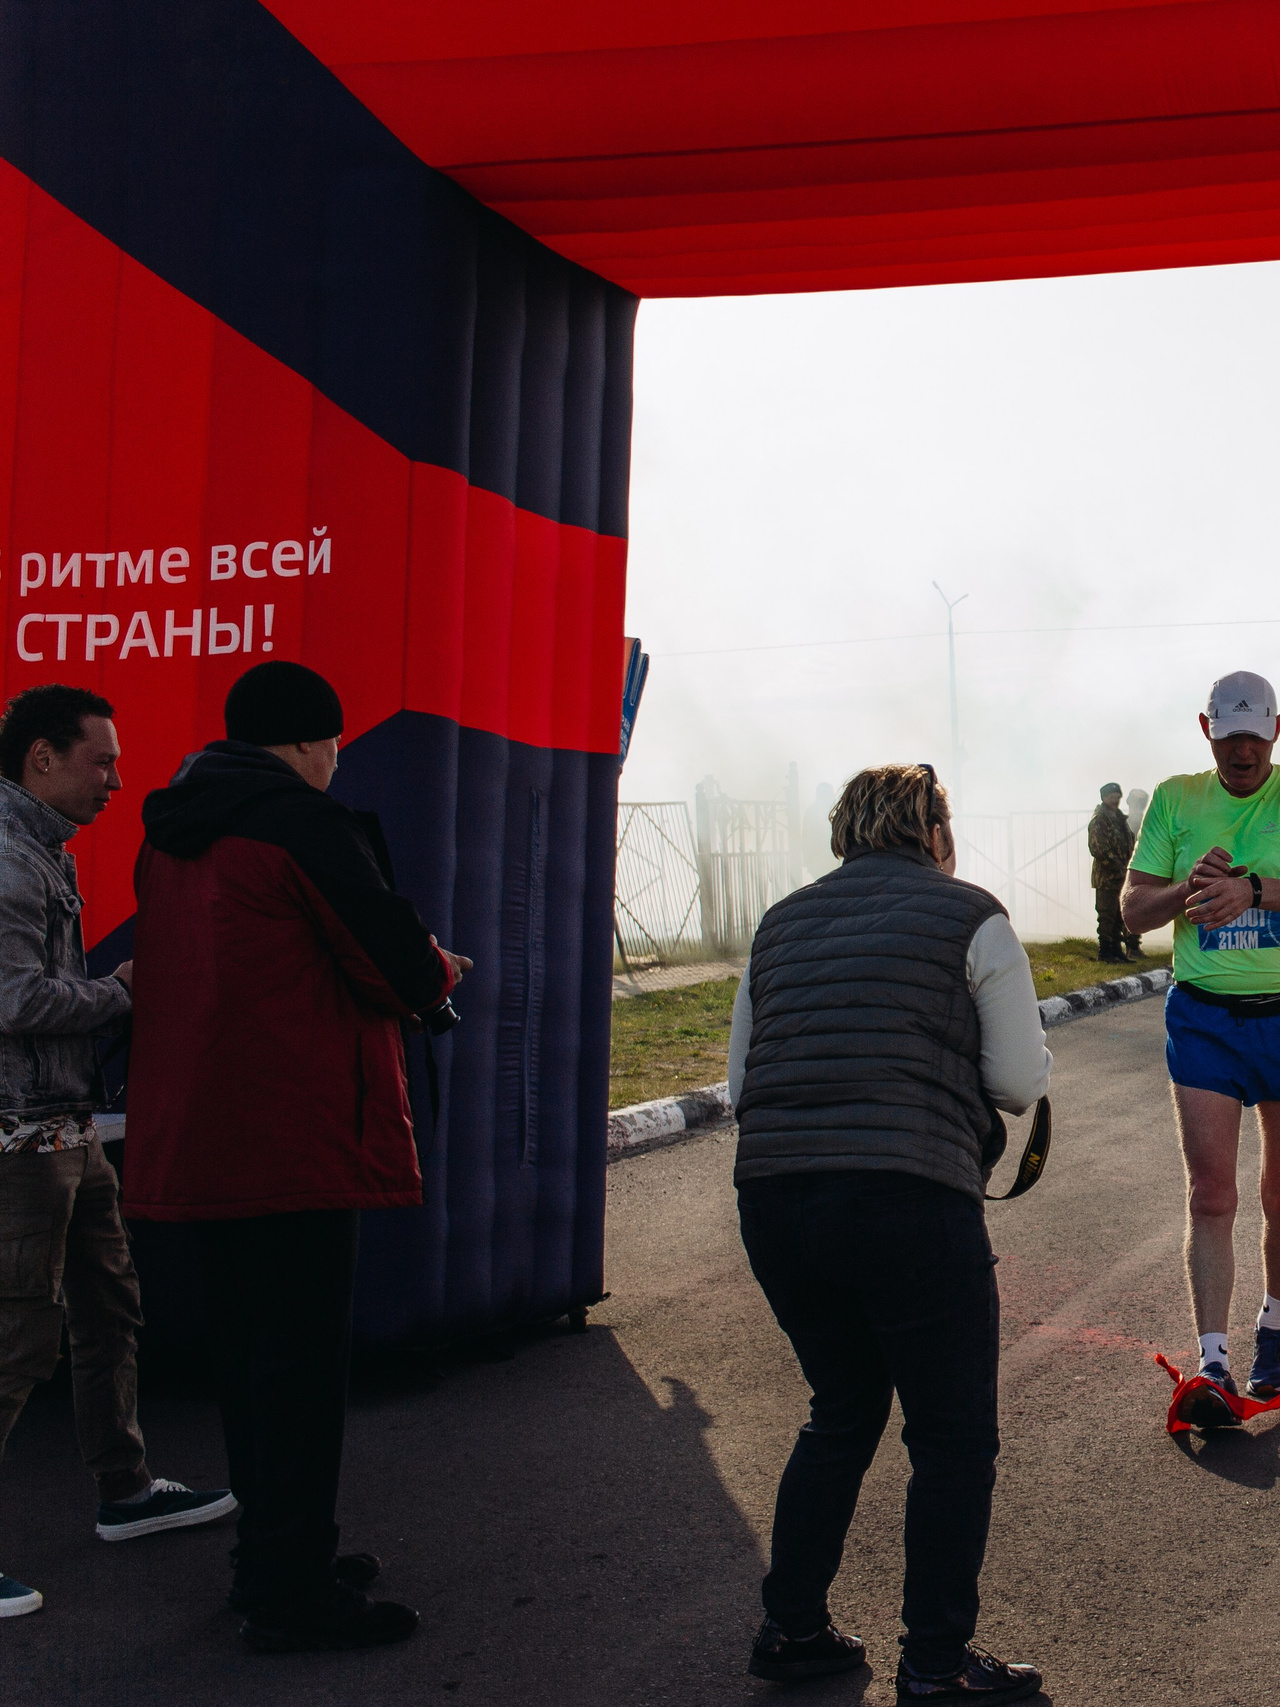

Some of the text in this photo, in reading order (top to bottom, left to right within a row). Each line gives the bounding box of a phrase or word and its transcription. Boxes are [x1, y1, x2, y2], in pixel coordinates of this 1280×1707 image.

[20, 526, 332, 597] ритме всей
[17, 603, 275, 662] СТРАНЫ!
[1218, 930, 1259, 950] 21.1KM
